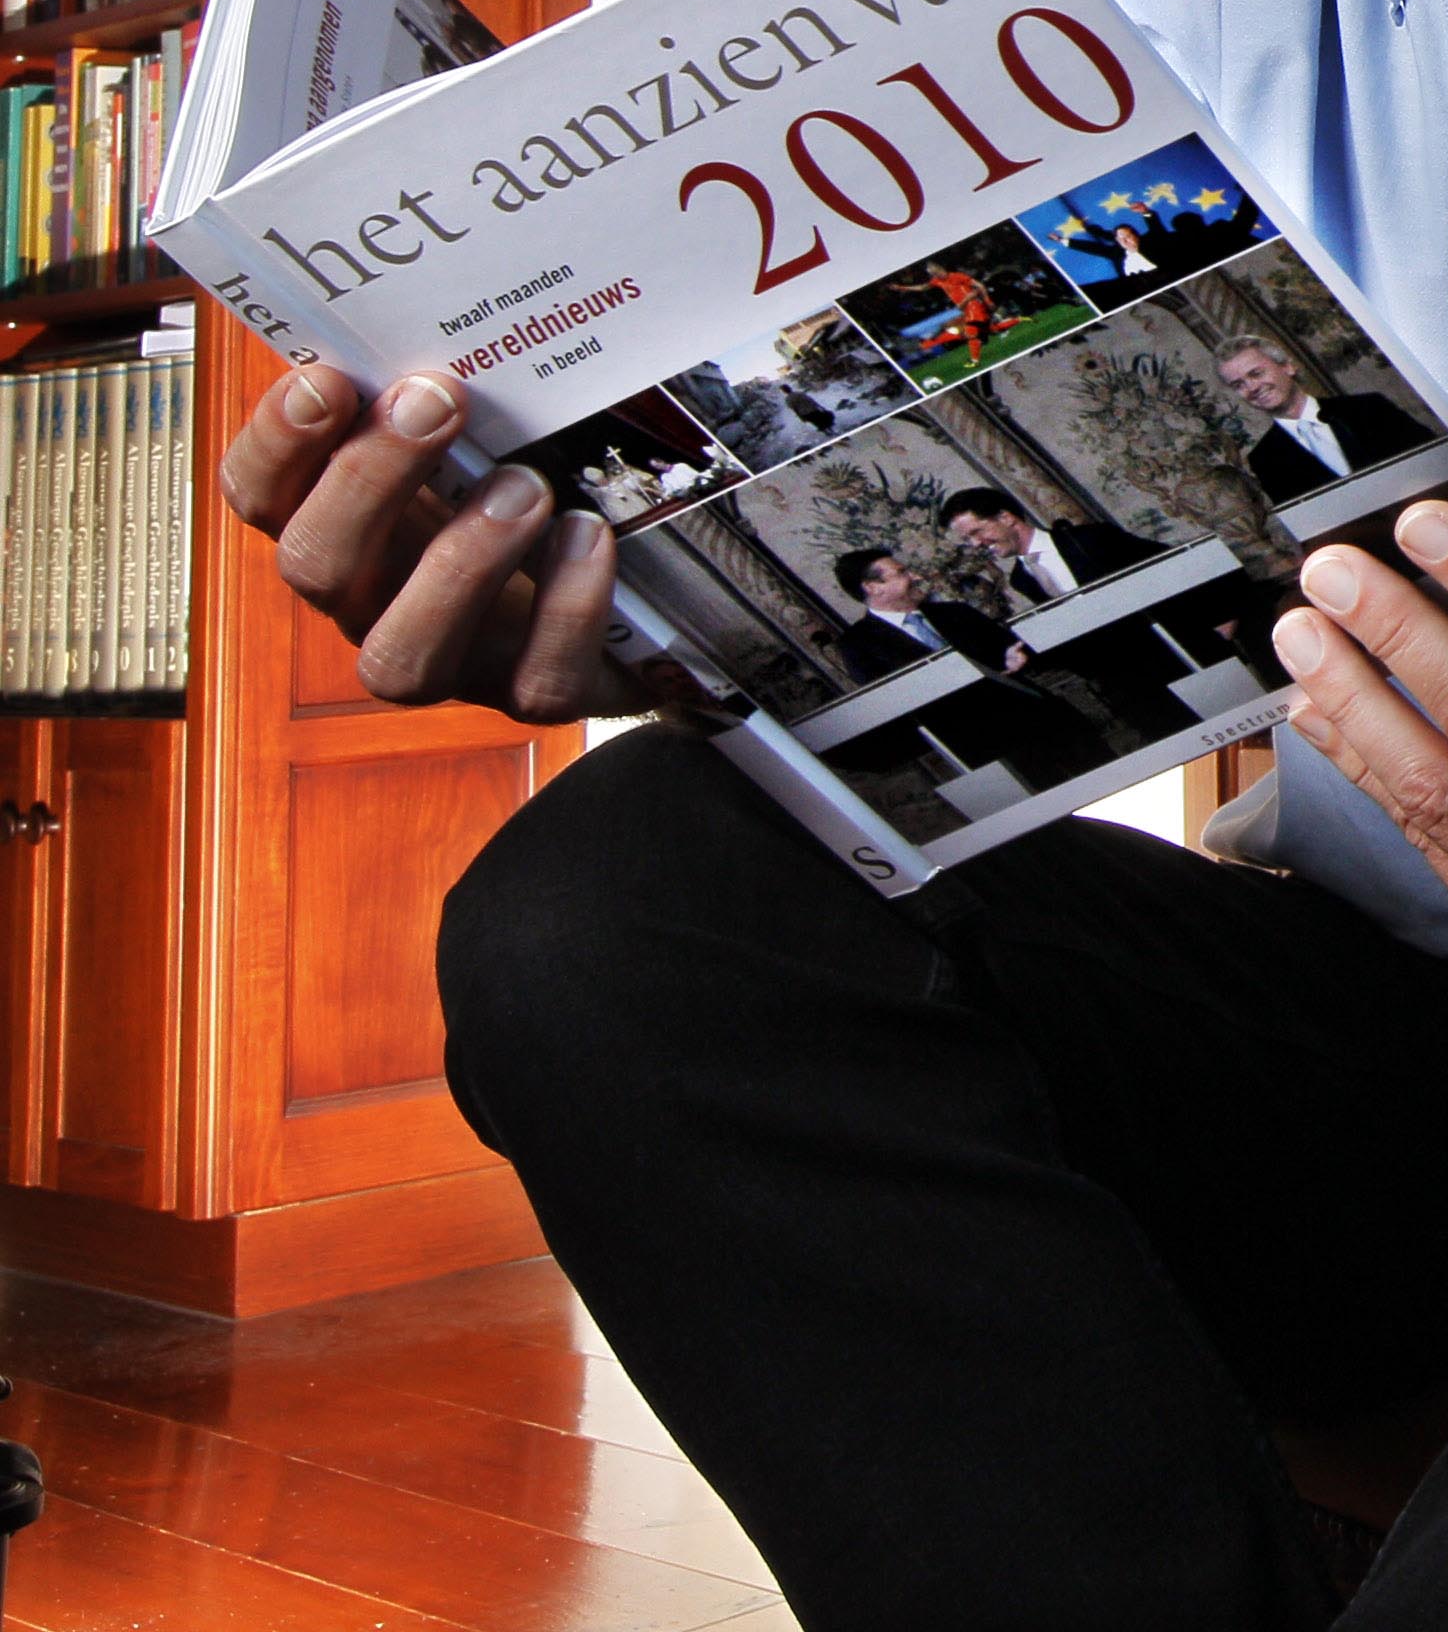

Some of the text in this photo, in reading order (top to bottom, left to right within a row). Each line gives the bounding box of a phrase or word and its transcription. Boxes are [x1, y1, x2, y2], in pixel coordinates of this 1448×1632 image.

[308, 0, 344, 122] aangenomen
[263, 190, 470, 302] het
[469, 8, 856, 214] aanzien
[680, 6, 1135, 294] 2010
[213, 272, 294, 342] het
[440, 264, 574, 337] twaalf maanden
[450, 276, 641, 380] wereldnieuws
[532, 336, 602, 379] in beeld
[1202, 701, 1291, 747] Spectrum
[851, 845, 897, 880] S
